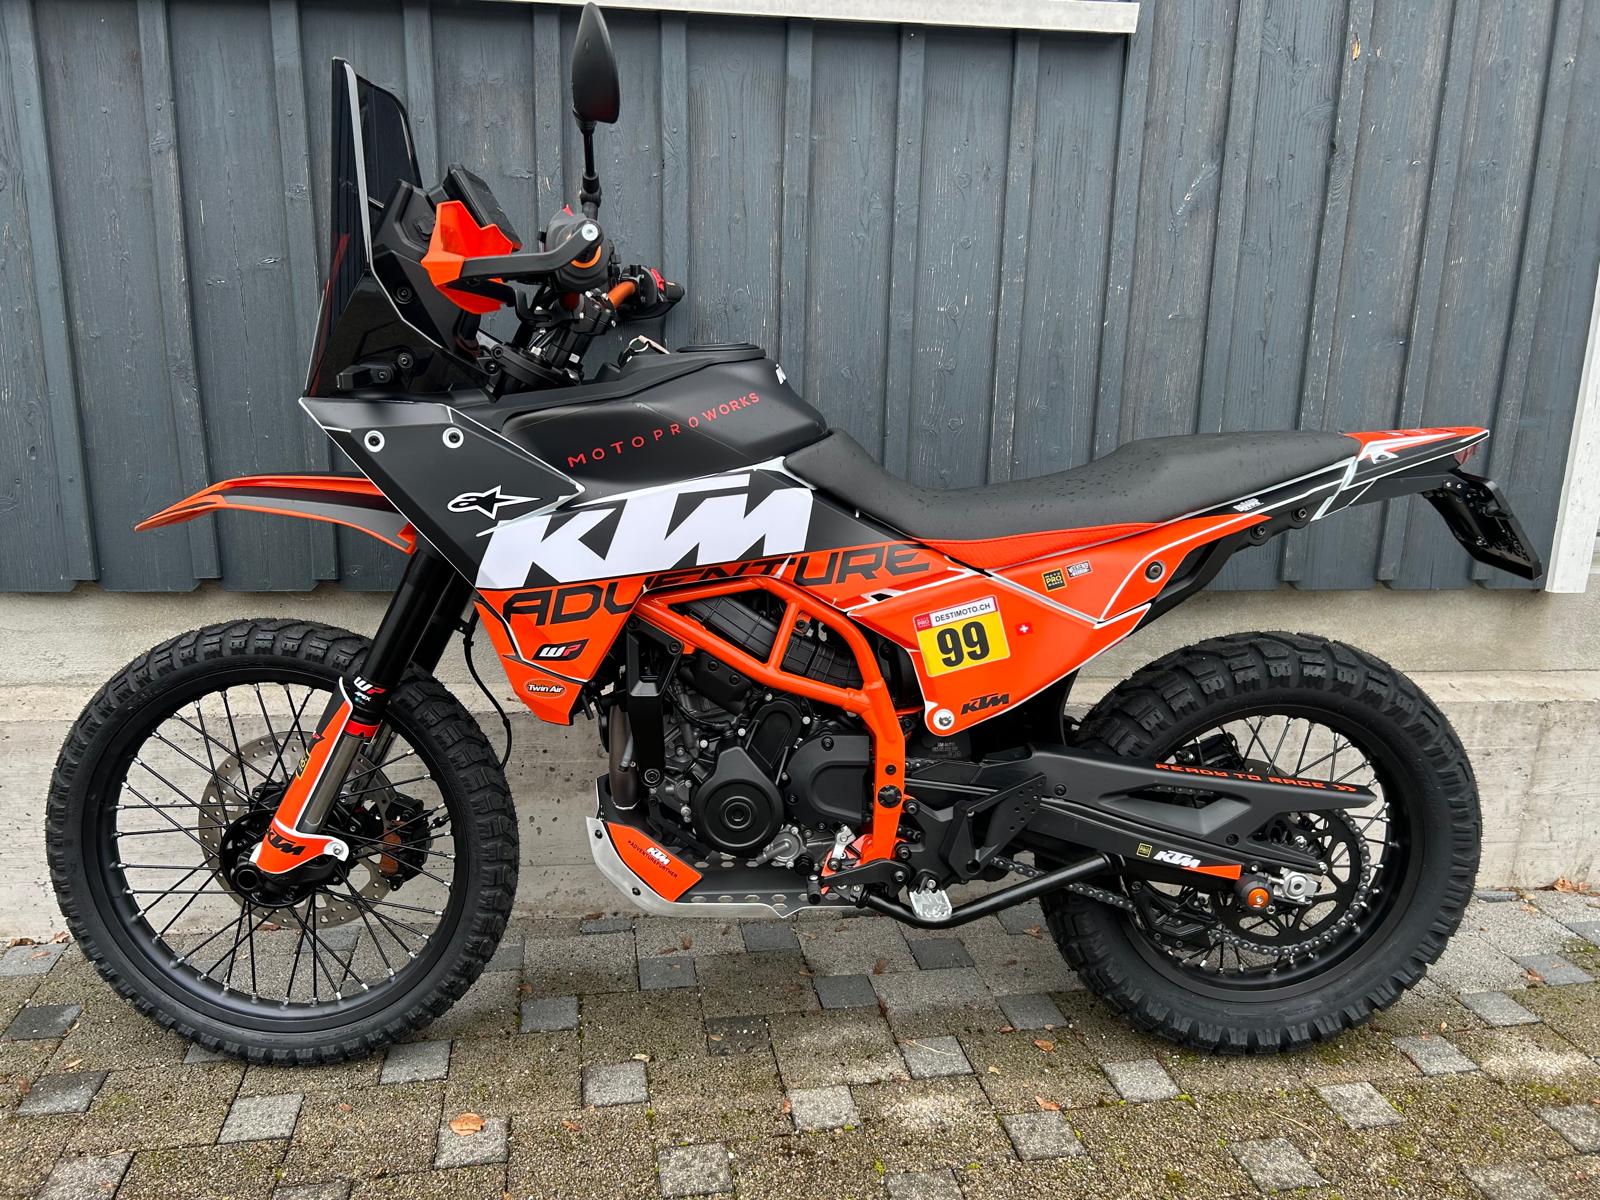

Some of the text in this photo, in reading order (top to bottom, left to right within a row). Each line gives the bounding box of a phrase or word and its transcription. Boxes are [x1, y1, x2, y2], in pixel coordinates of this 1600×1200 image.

[475, 472, 814, 589] KTM
[935, 602, 991, 623] DESTIMOTO.CH
[538, 643, 583, 658] WP
[936, 621, 990, 668] 99
[353, 676, 387, 695] WP
[528, 683, 565, 693] Twin Air
[960, 693, 1010, 715] KTM
[1154, 763, 1327, 790] READY TO RACE
[267, 828, 307, 856] KTM
[646, 846, 671, 865] KTM
[1152, 850, 1201, 869] KTM
